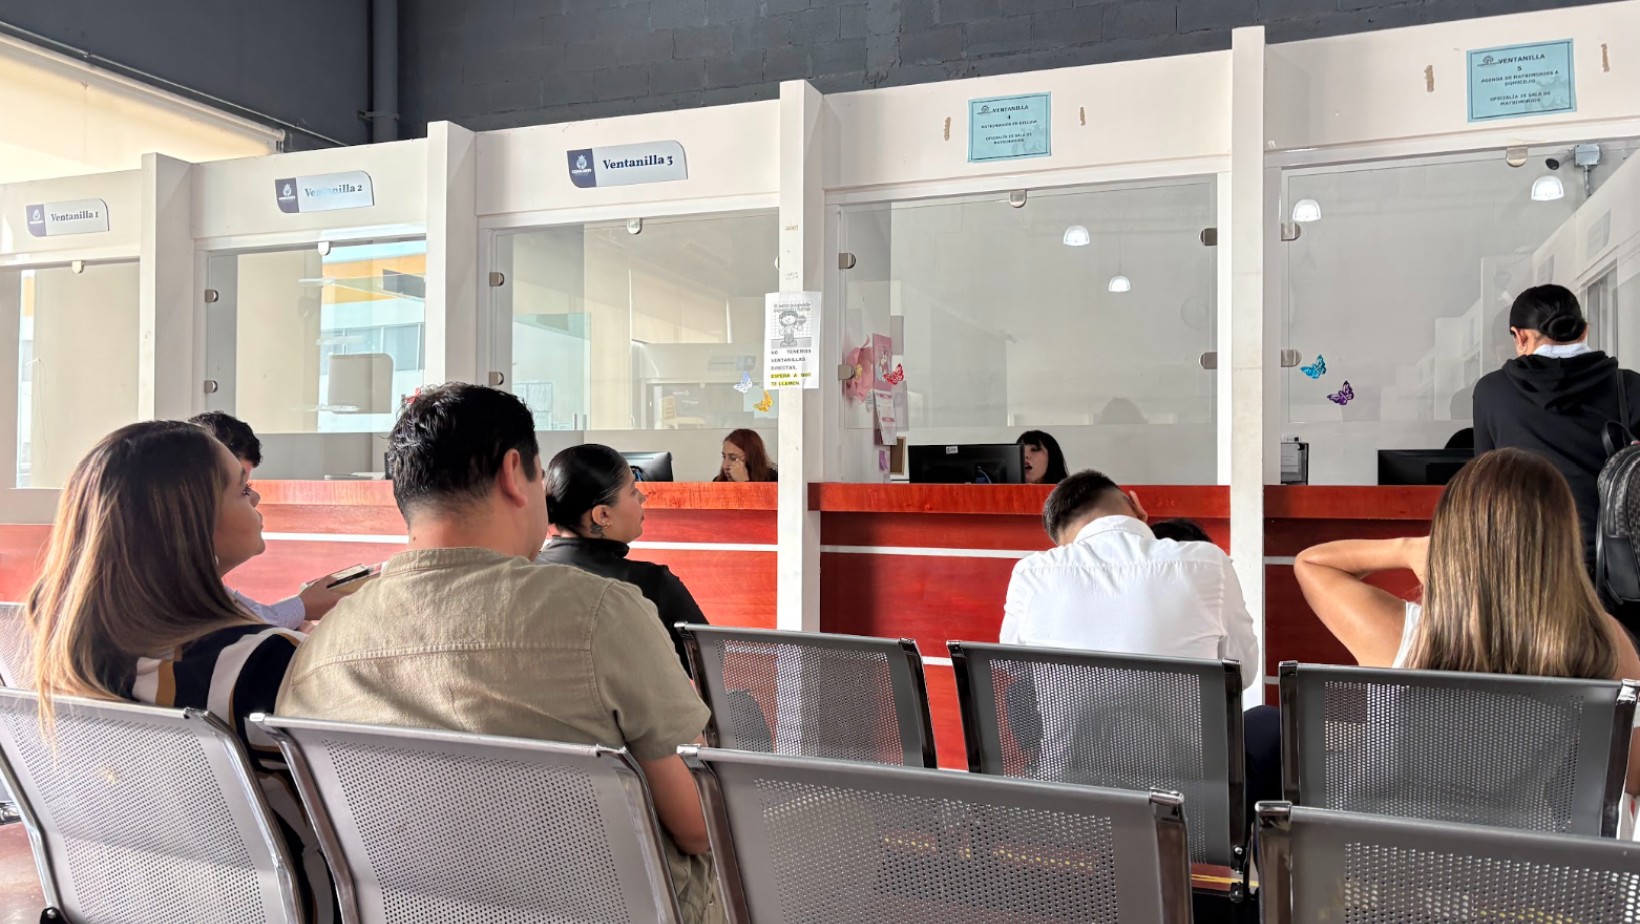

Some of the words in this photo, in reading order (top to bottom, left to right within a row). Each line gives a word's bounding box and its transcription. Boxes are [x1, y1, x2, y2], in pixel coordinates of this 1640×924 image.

[1498, 53, 1545, 64] VENTANILLA
[992, 104, 1029, 113] VENTANILLA
[602, 154, 664, 170] Ventanilla
[667, 155, 673, 166] 3
[357, 184, 363, 192] 2
[50, 210, 94, 222] Ventanilla
